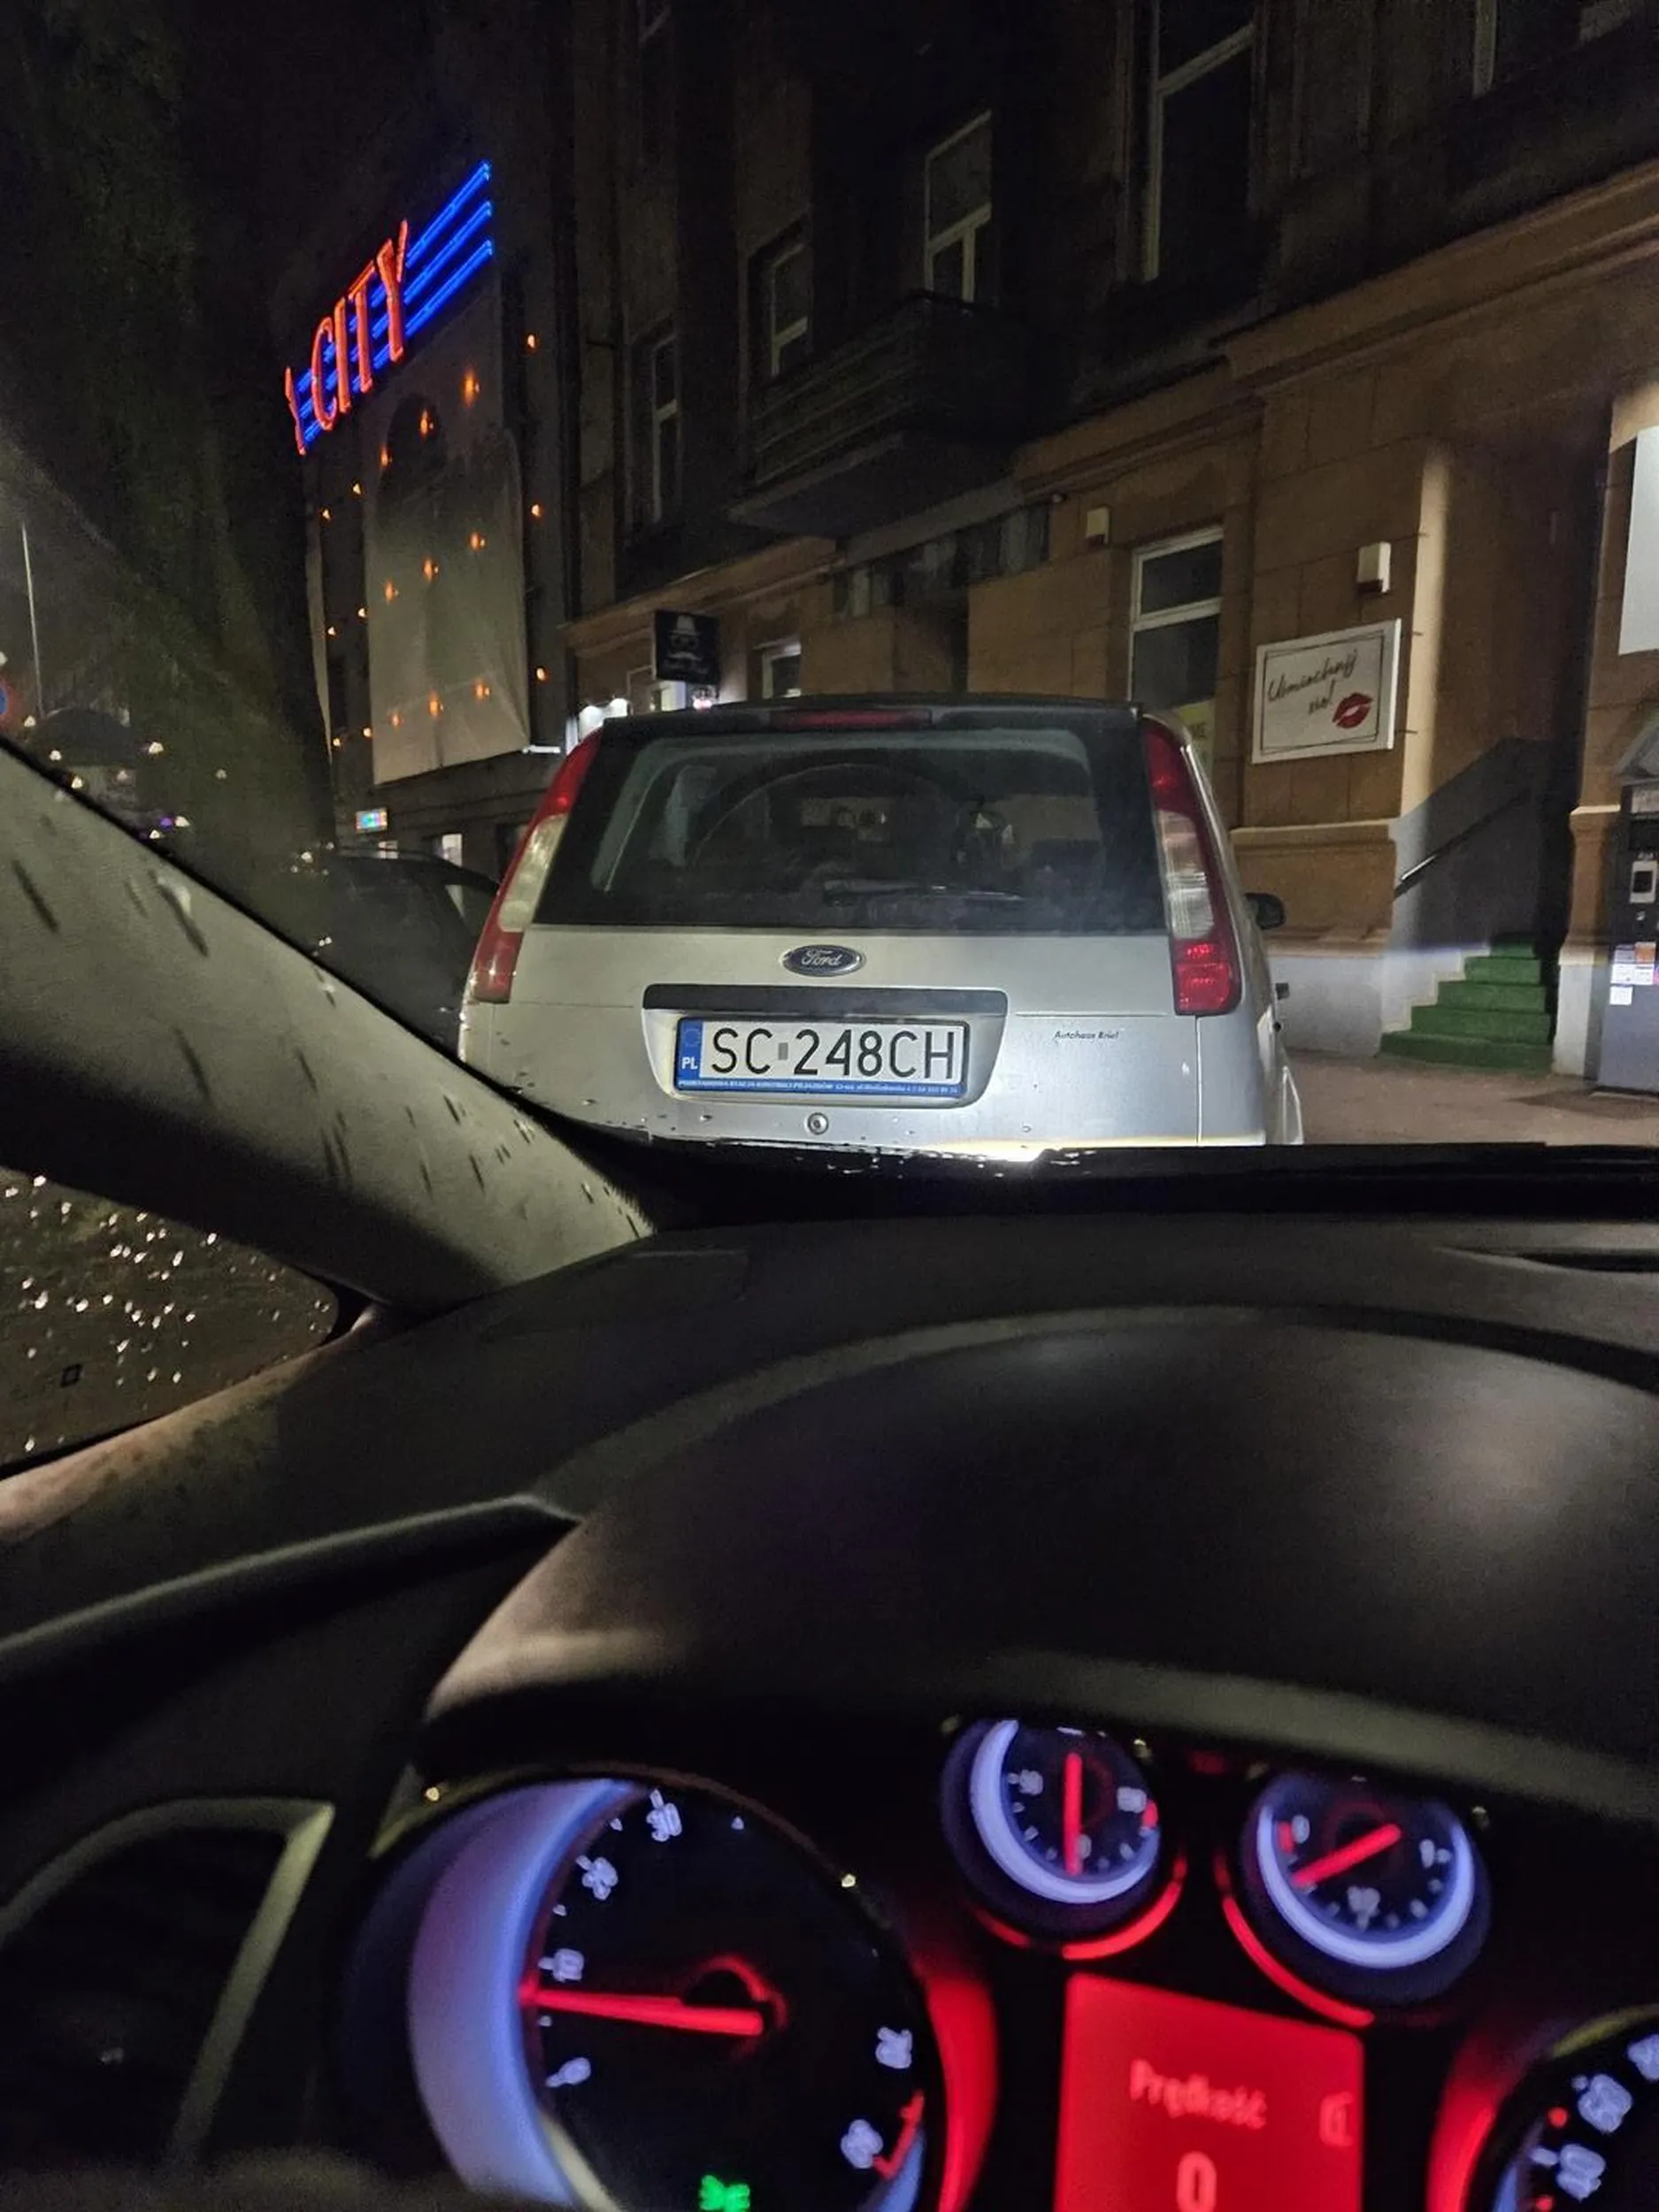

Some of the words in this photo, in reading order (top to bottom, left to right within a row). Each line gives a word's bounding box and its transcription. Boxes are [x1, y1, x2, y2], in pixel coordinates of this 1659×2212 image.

[310, 219, 408, 432] CITY
[802, 949, 843, 966] Ford
[681, 1056, 698, 1070] PL
[710, 1026, 773, 1074] SC
[793, 1028, 955, 1079] 248CH
